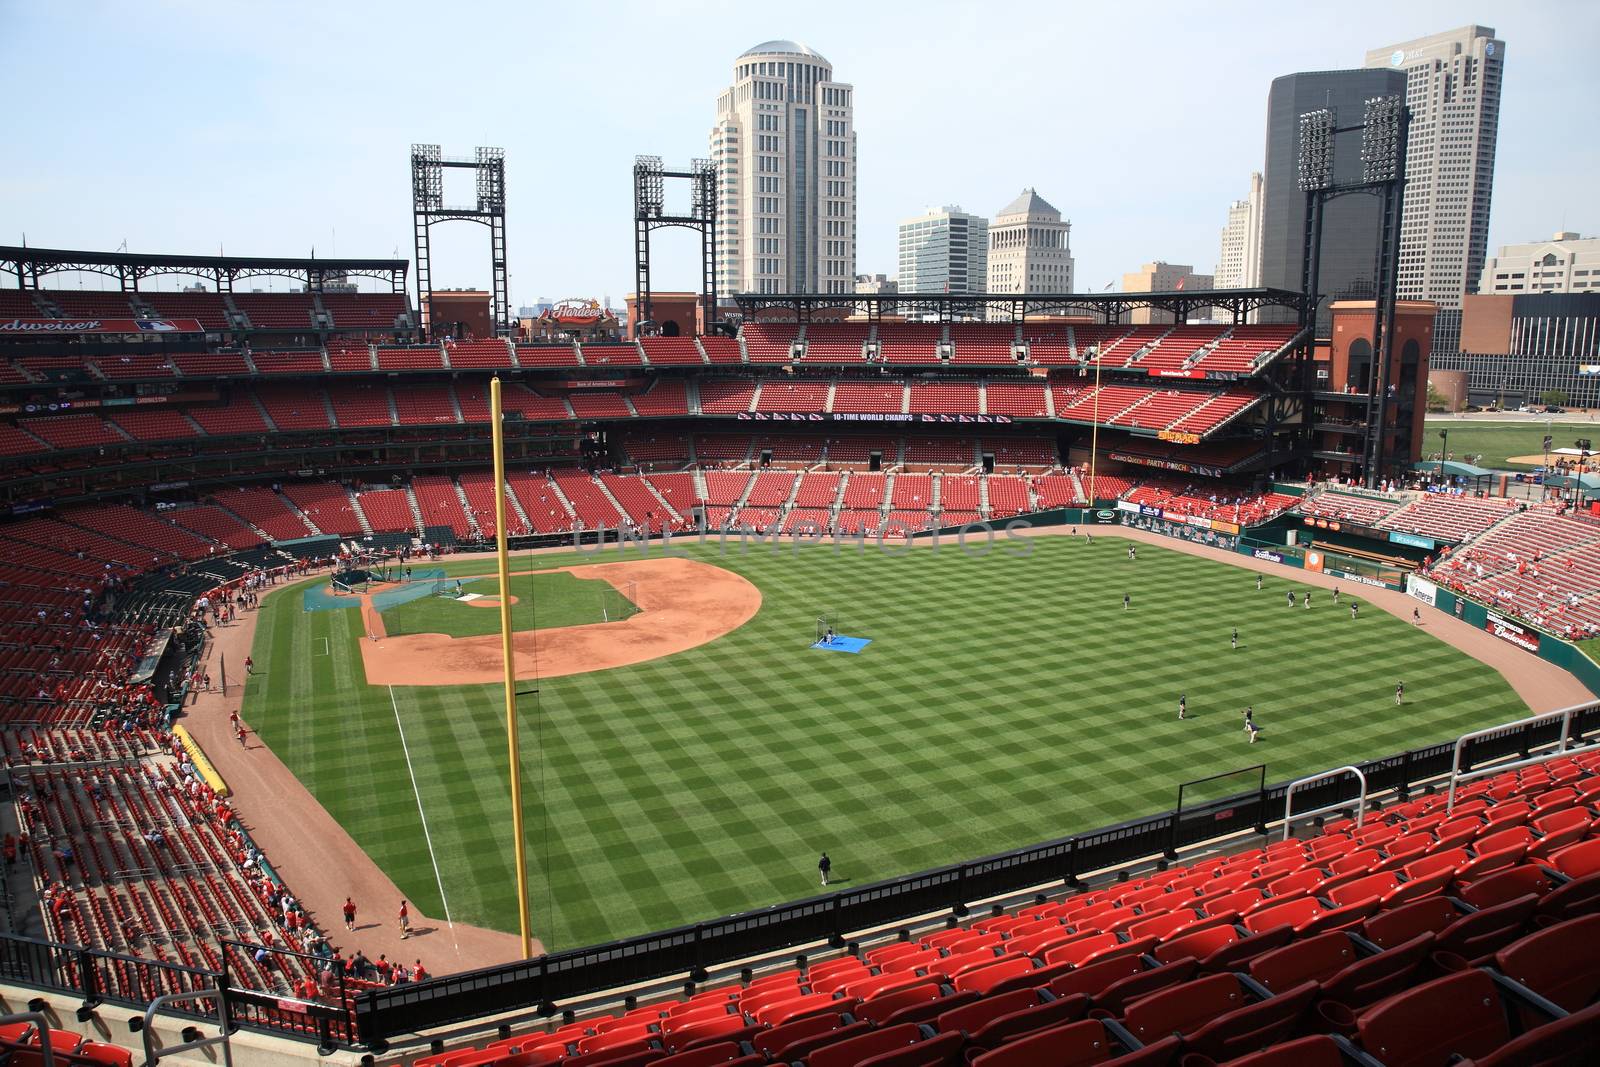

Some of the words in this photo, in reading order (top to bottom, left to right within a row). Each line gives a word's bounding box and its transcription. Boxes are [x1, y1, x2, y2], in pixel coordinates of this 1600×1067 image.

[0, 320, 101, 331] dweiser
[833, 413, 859, 421] 10-TIME
[884, 414, 913, 422] CHAMPS
[1147, 459, 1165, 468] PARTY
[1414, 587, 1433, 604] Ameren
[1493, 623, 1538, 651] Budweiser
